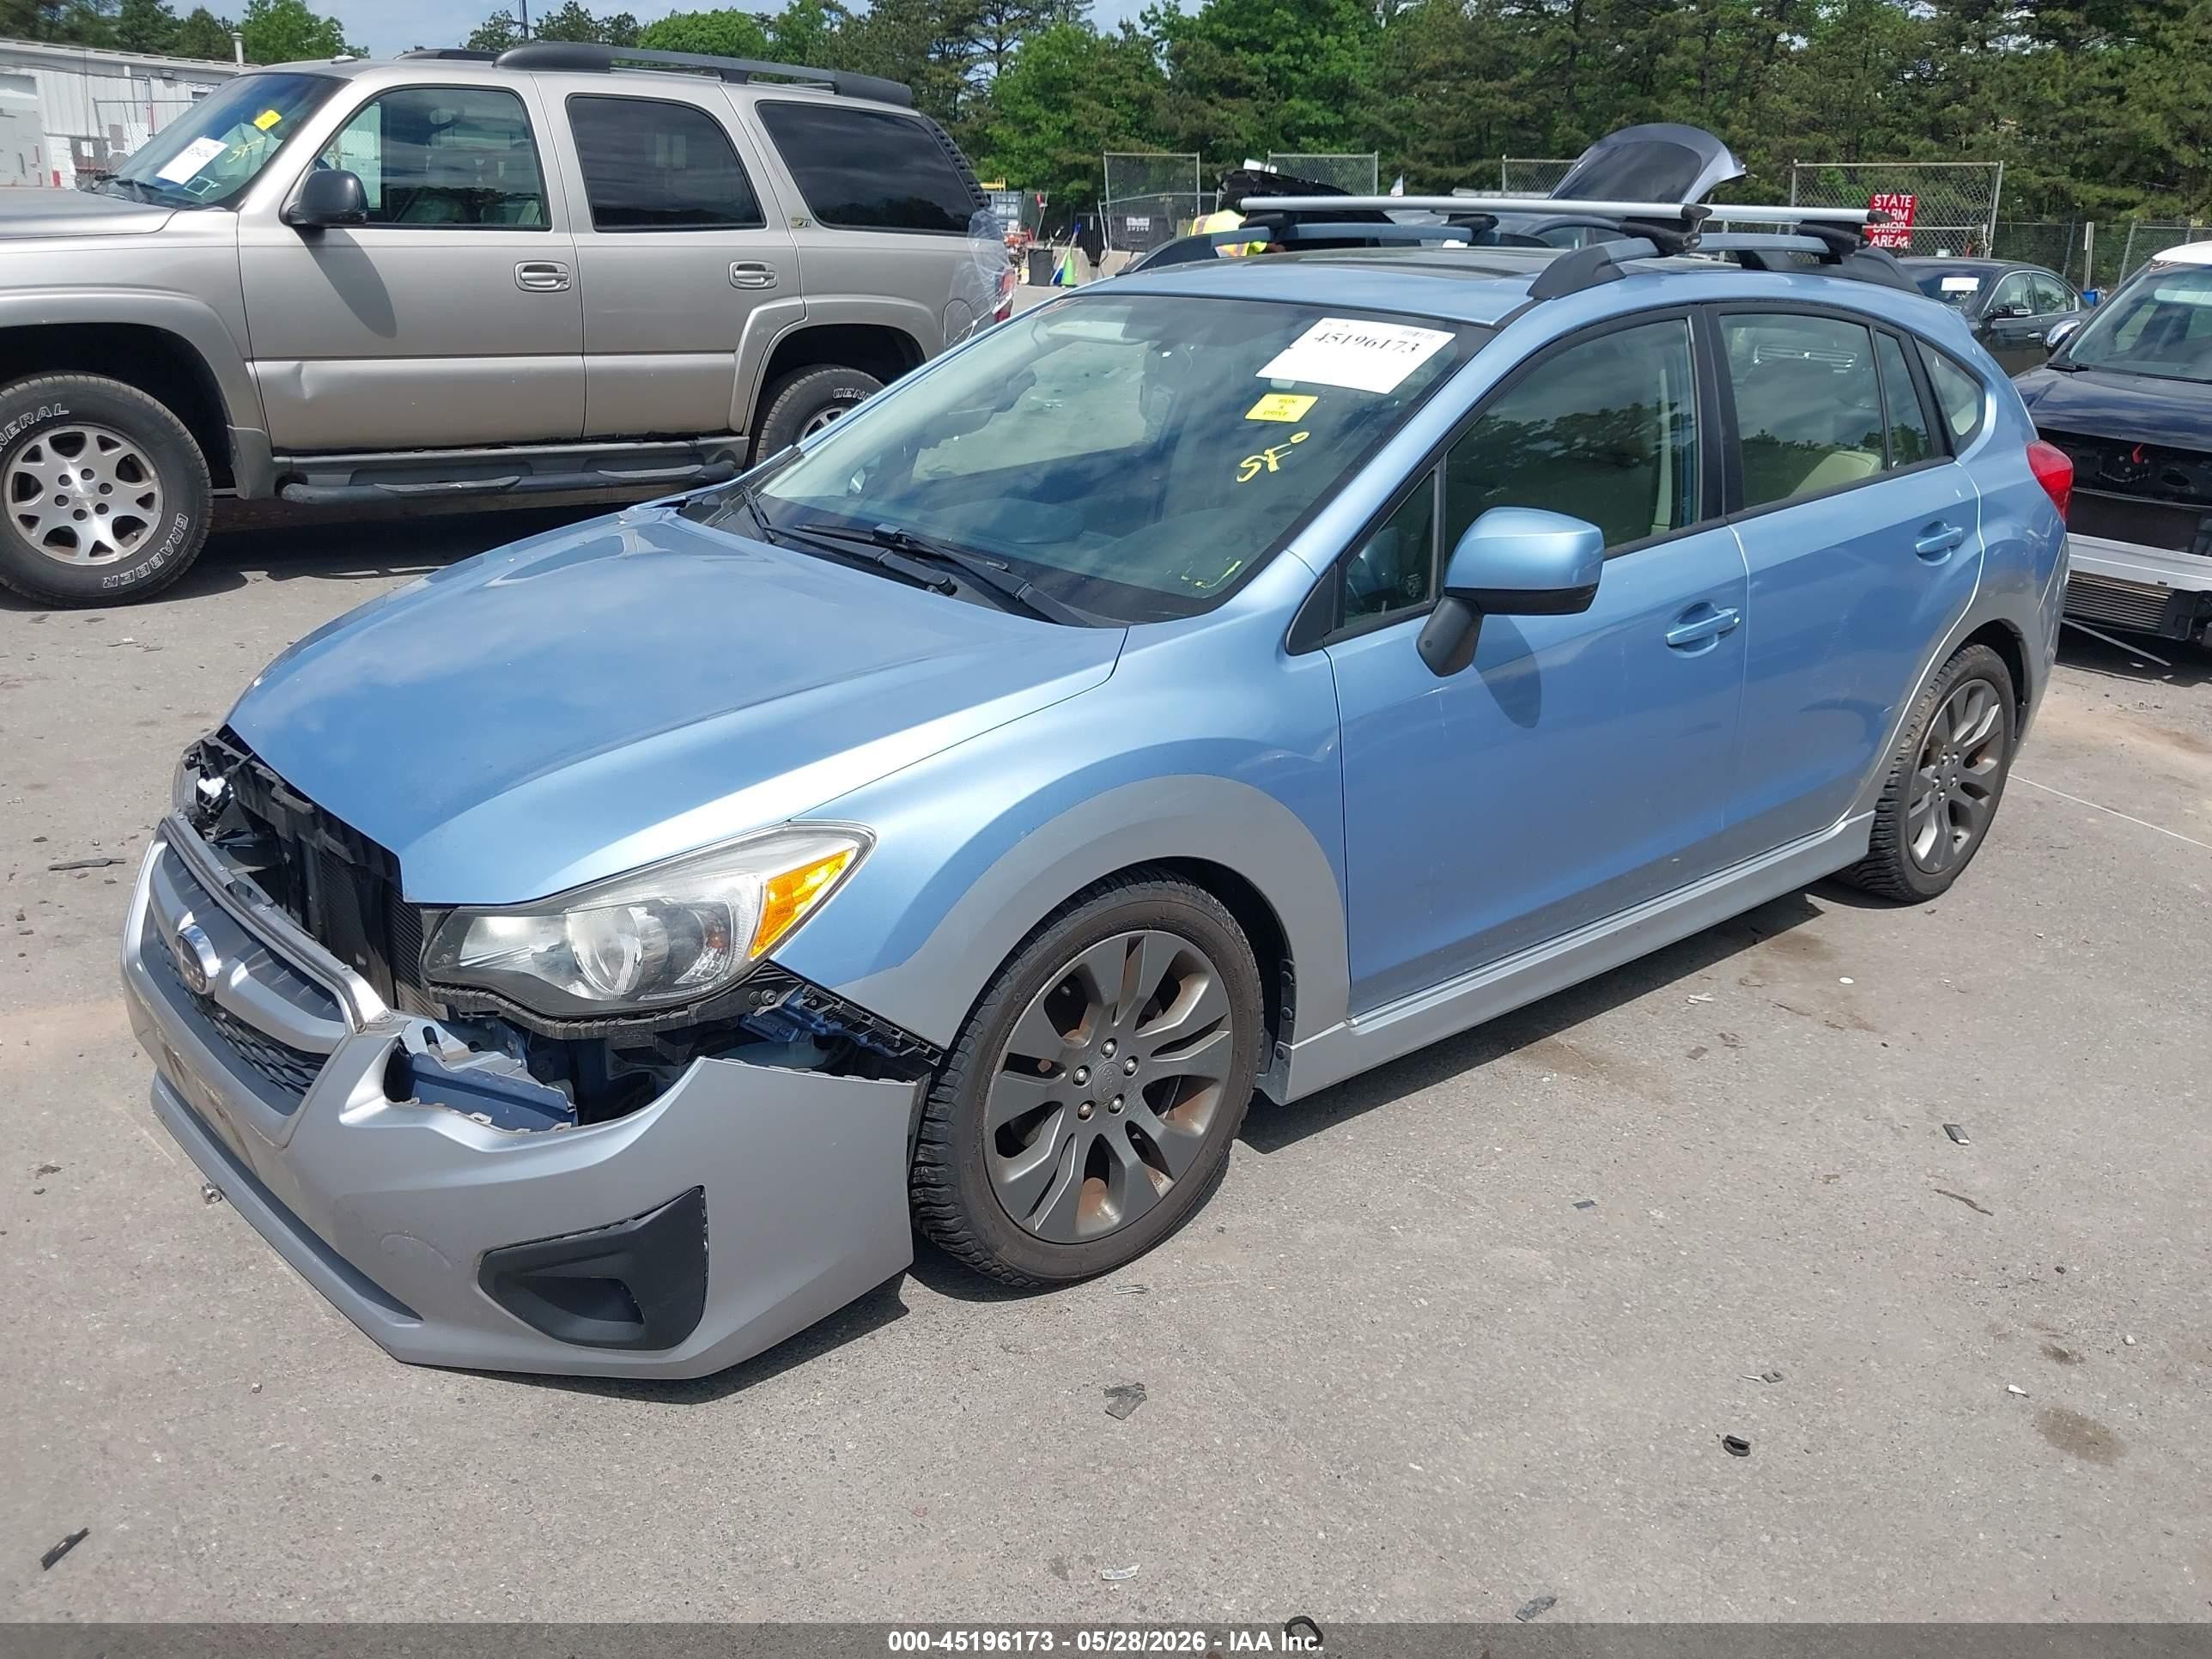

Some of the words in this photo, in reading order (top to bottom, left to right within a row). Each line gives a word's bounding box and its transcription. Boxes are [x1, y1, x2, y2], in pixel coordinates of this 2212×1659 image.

[1874, 194, 1912, 207] STATE
[1875, 208, 1909, 221] RM
[1870, 234, 1904, 248] AREA
[1314, 331, 1420, 354] 45196173
[0, 403, 70, 452] NERAL
[102, 513, 189, 589] GRABBER
